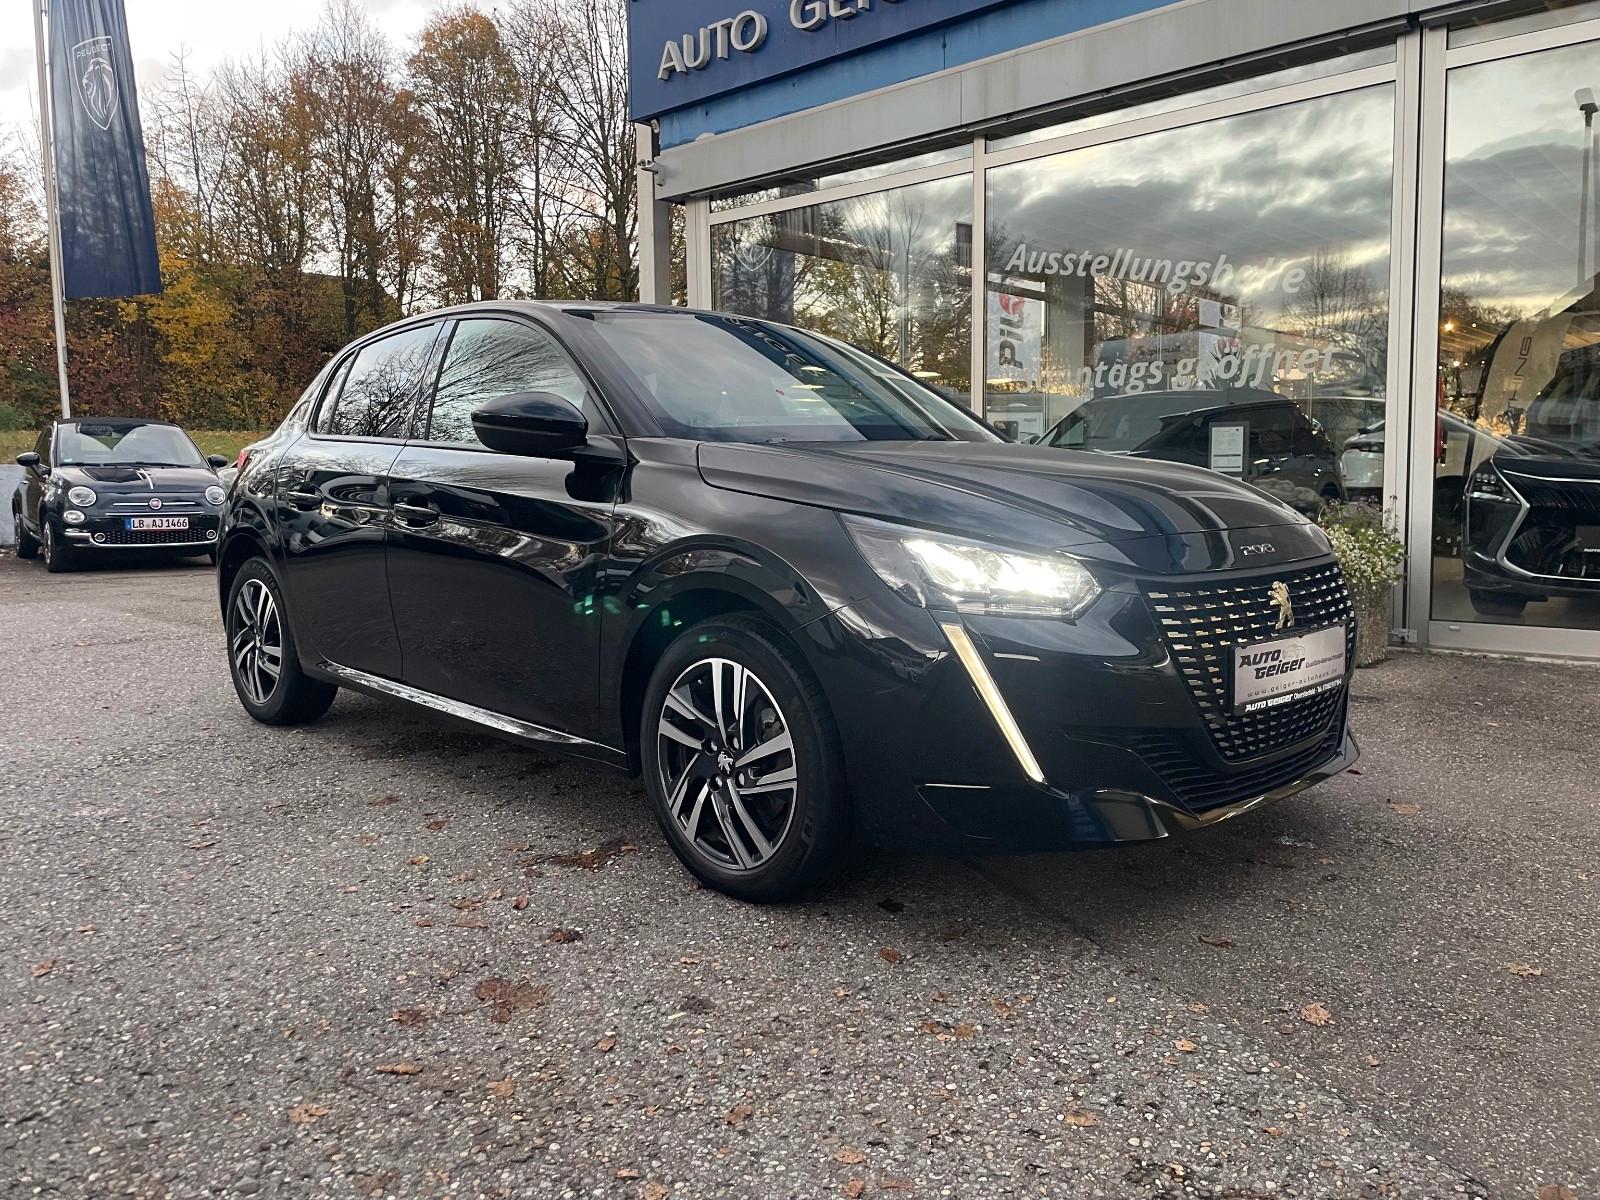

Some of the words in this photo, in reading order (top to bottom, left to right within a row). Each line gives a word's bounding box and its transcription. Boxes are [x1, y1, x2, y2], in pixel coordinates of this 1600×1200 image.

[658, 10, 767, 80] AUTO
[1017, 354, 1166, 395] Sntags
[132, 519, 145, 529] LB
[1239, 649, 1282, 668] AUTO
[1245, 700, 1267, 712] AUTO
